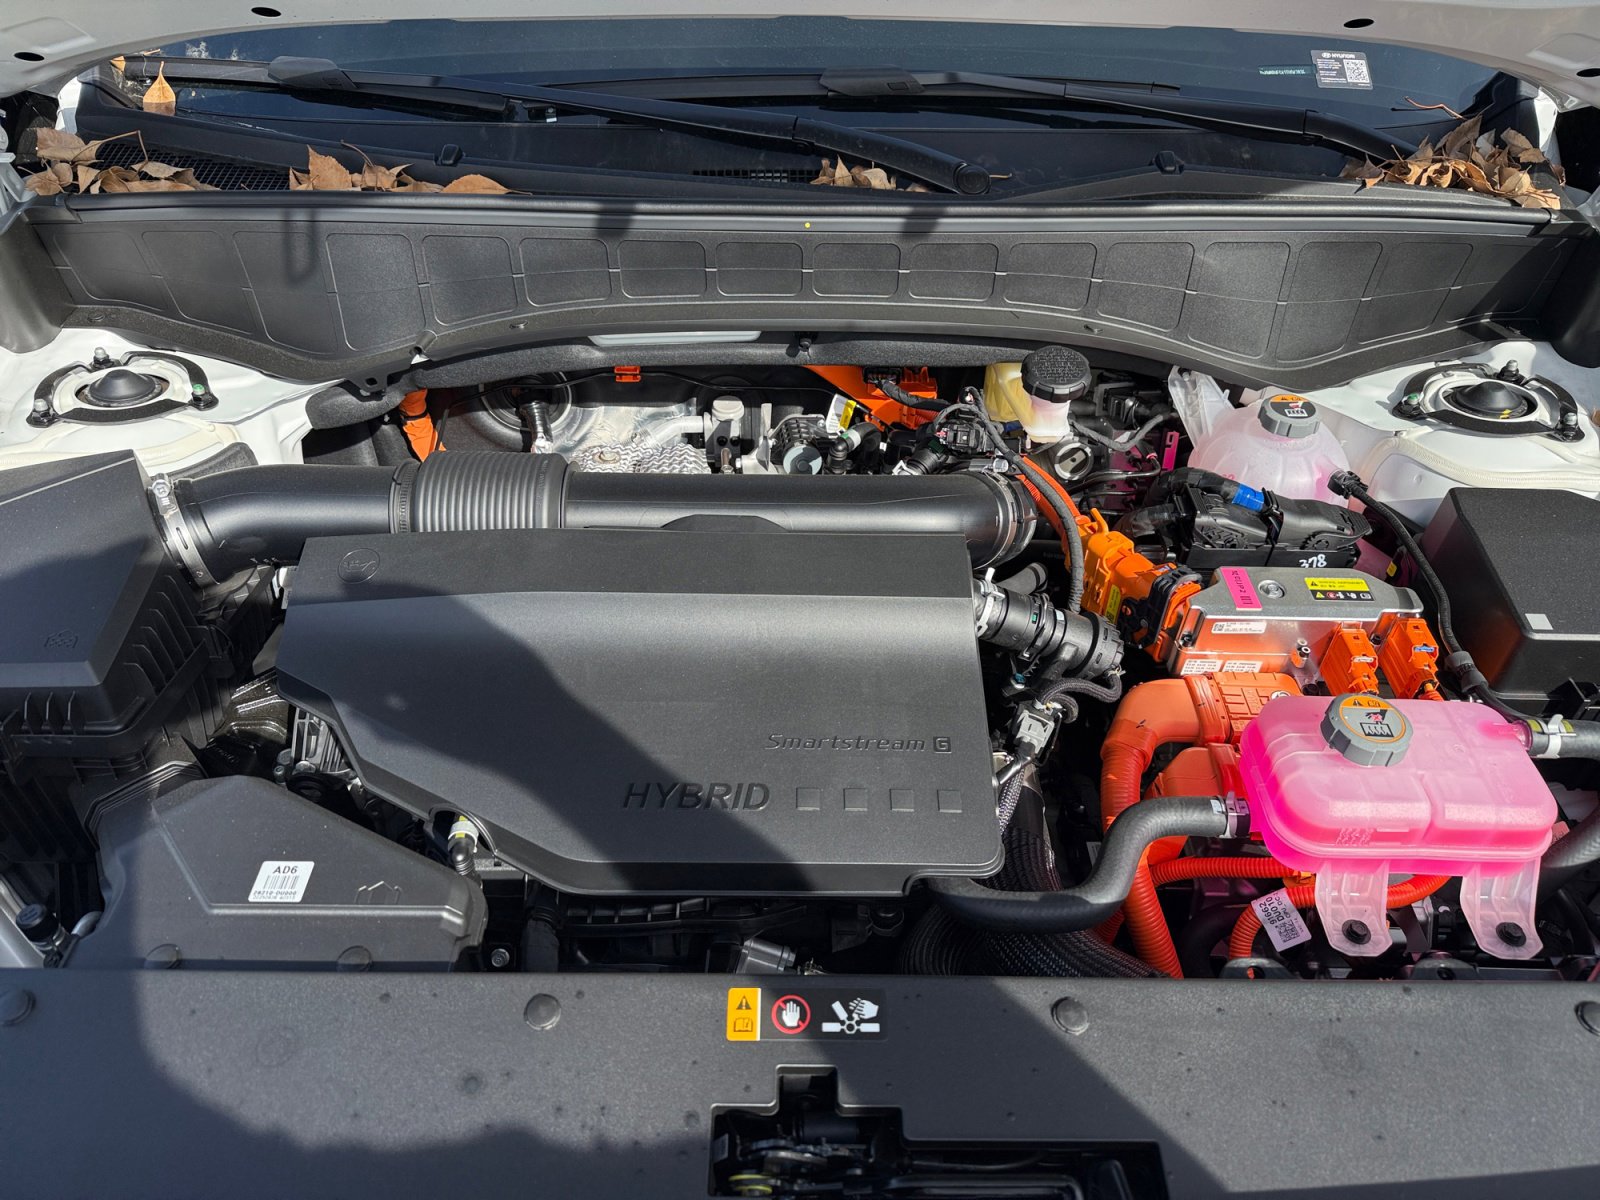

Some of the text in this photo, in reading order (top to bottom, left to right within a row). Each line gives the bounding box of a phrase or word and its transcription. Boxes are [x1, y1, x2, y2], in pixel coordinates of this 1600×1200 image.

[1299, 553, 1327, 569] 378
[765, 735, 925, 751] Smartstream
[622, 781, 770, 812] HYBRID
[272, 865, 299, 874] AD6
[1259, 901, 1278, 925] 91662
